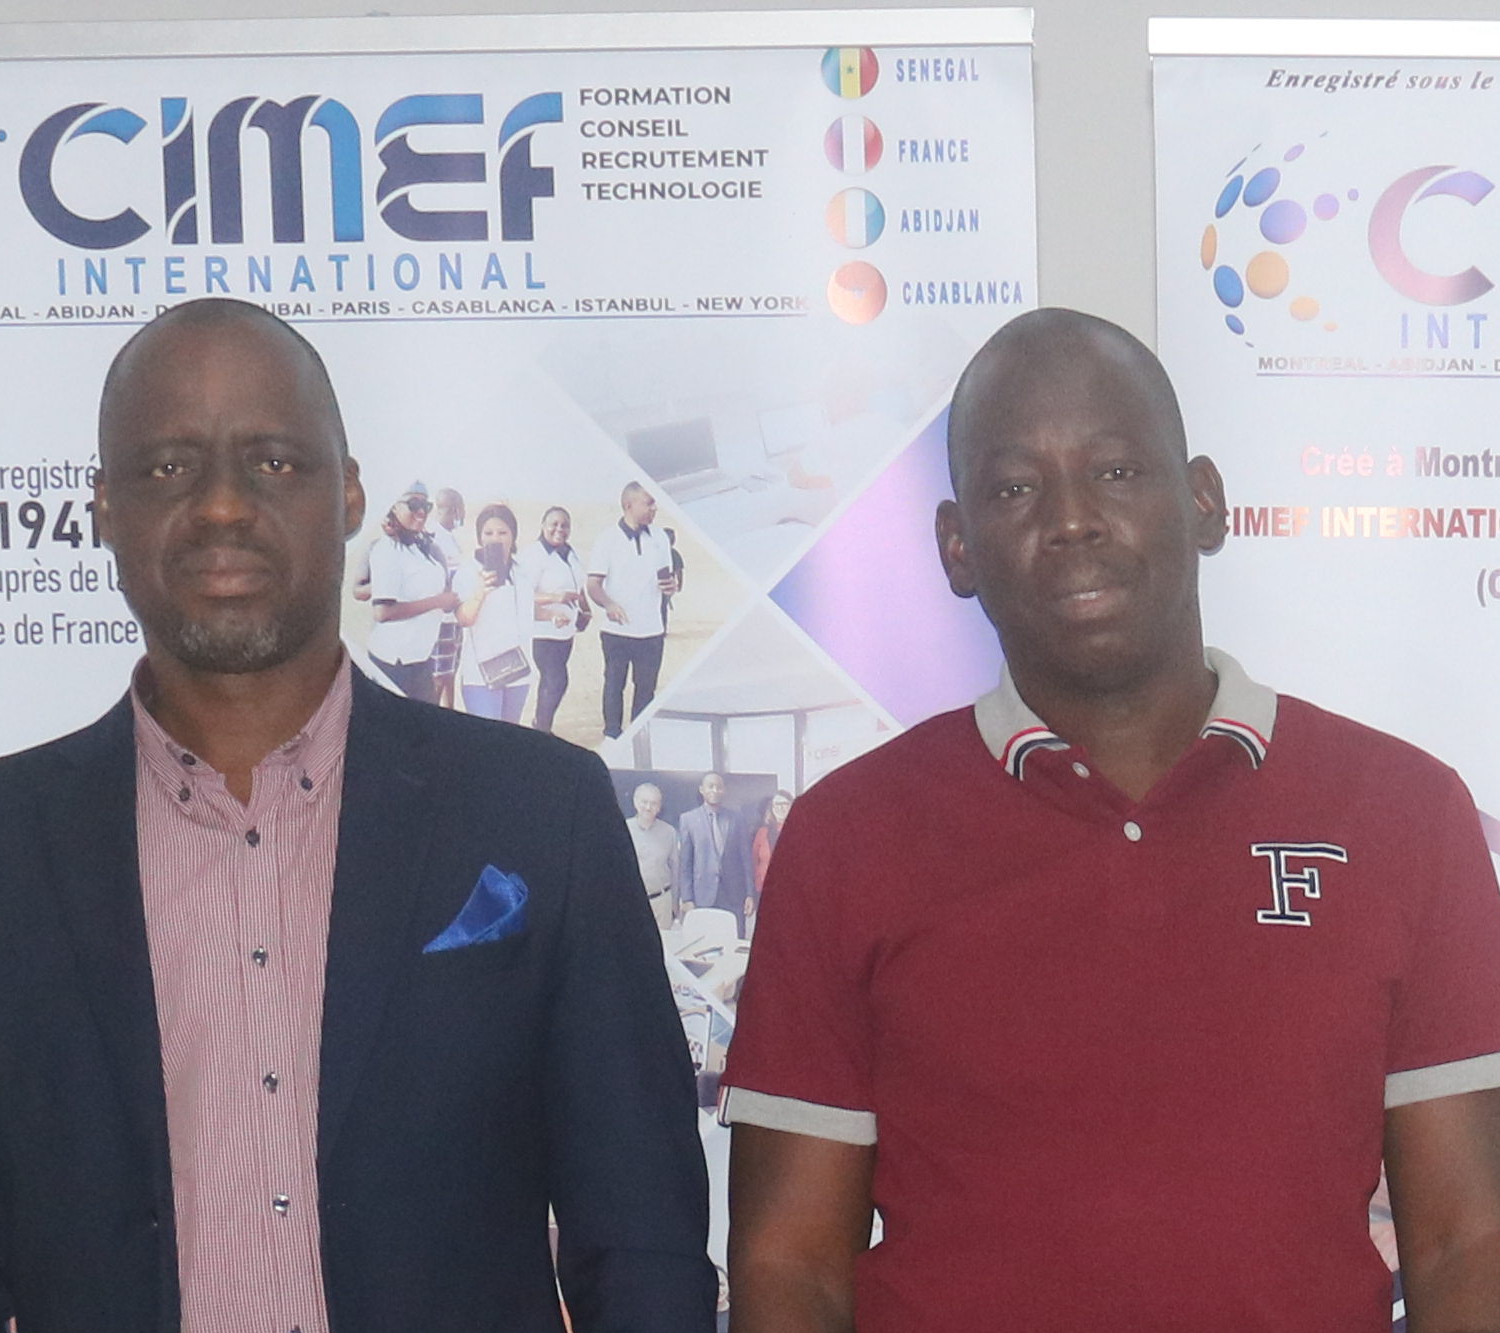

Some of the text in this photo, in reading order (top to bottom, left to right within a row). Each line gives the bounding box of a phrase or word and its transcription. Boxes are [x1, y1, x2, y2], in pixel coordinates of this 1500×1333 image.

[895, 58, 980, 83] SENEGAL
[1265, 69, 1401, 93] Enregistré
[1406, 73, 1462, 91] sous
[1470, 70, 1494, 91] le
[579, 86, 732, 107] FORMATION
[580, 118, 690, 138] CONSEIL
[581, 149, 769, 171] RECRUTEMENT
[898, 139, 970, 164] FRANCE
[581, 180, 763, 201] TECHNOLOGIE
[900, 208, 981, 233] ABIDJAN
[57, 251, 547, 296] INTERNATIONAL
[902, 280, 1024, 305] CASABLANCA
[46, 304, 136, 319] ABIDJAN
[331, 301, 391, 315] PARIS
[411, 298, 556, 315] CASABLANCA
[574, 297, 676, 313] ISTANBUL
[696, 296, 743, 312] NEW
[748, 295, 809, 311] YORK
[1257, 356, 1369, 372] MONTREAL
[1387, 357, 1475, 372] ABIDJAN
[1301, 445, 1377, 478] Créé
[1386, 445, 1403, 478] à
[1224, 506, 1311, 537] IMEF
[69, 560, 99, 592] de
[14, 613, 44, 645] de
[51, 612, 140, 645] France
[1250, 842, 1349, 927] F
